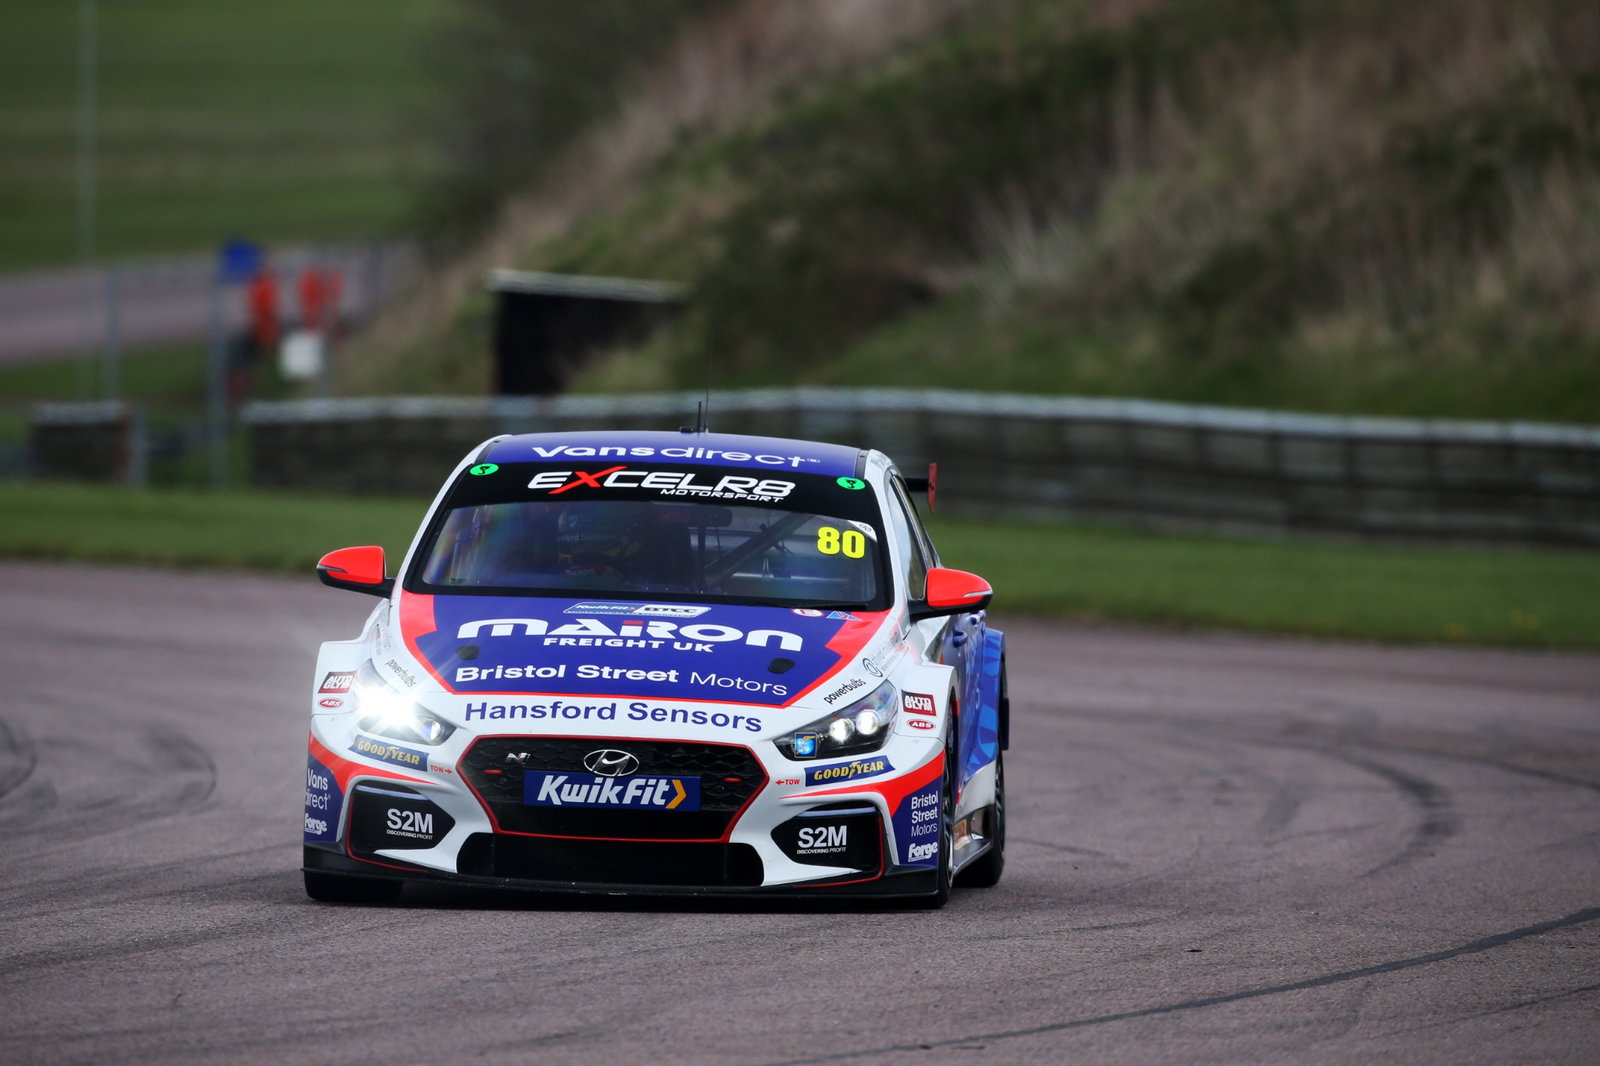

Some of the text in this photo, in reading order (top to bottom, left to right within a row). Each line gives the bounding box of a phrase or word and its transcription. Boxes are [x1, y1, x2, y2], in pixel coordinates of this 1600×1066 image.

[660, 488, 784, 502] MOTORSPORT
[817, 526, 865, 559] 80
[543, 638, 715, 653] FREIGHT UK
[455, 664, 788, 696] Bristol Street Motors
[823, 678, 867, 705] powerbulbs
[465, 701, 762, 732] Hansford Sensors
[307, 768, 328, 790] Vans
[911, 791, 938, 809] Bristol
[386, 808, 433, 834] S2M
[911, 806, 938, 823] Street
[798, 825, 847, 848] S2M
[911, 822, 938, 837] Motors
